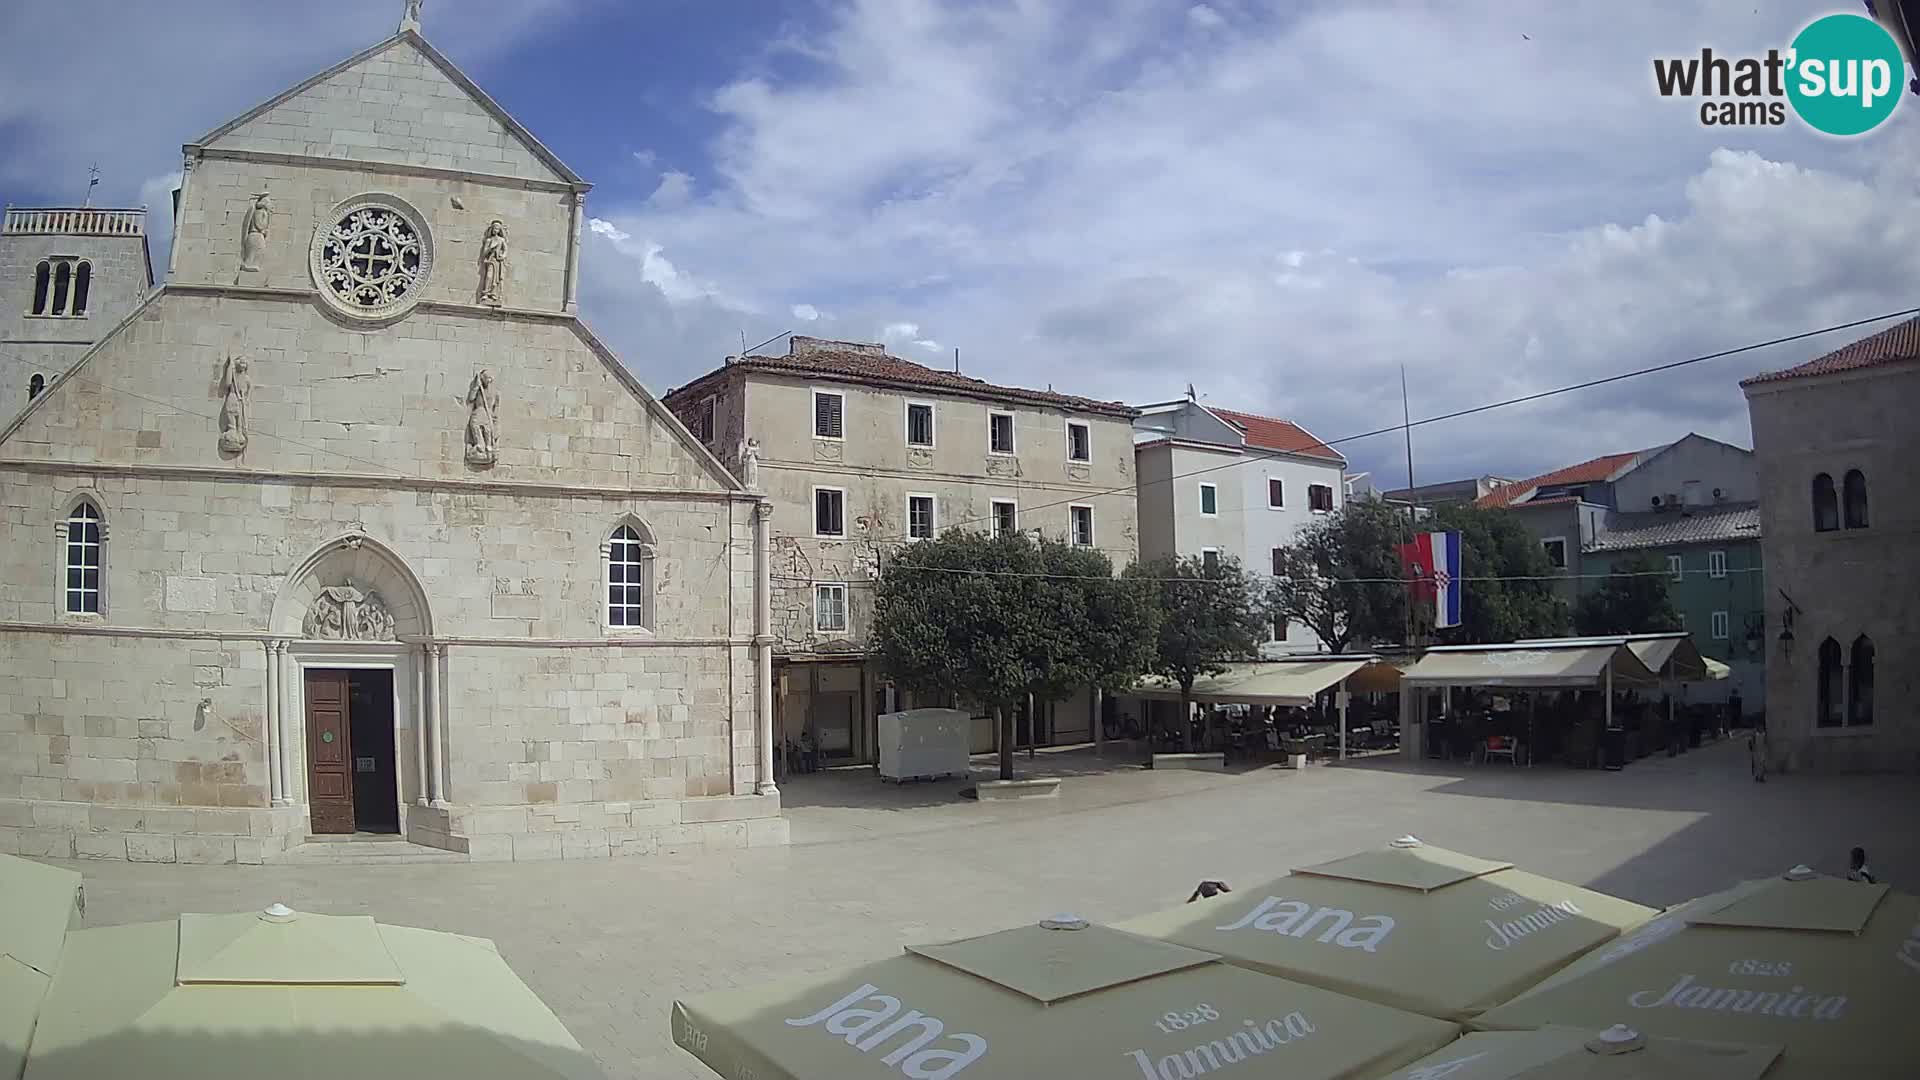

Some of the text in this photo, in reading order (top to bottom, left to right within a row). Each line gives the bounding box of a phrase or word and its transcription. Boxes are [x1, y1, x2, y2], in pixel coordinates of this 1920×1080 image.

[1216, 896, 1395, 952] Jana
[1728, 960, 1793, 976] 1828
[1154, 1003, 1220, 1033] 1828
[1629, 975, 1848, 1021] Jamnica
[784, 983, 987, 1080] Jana
